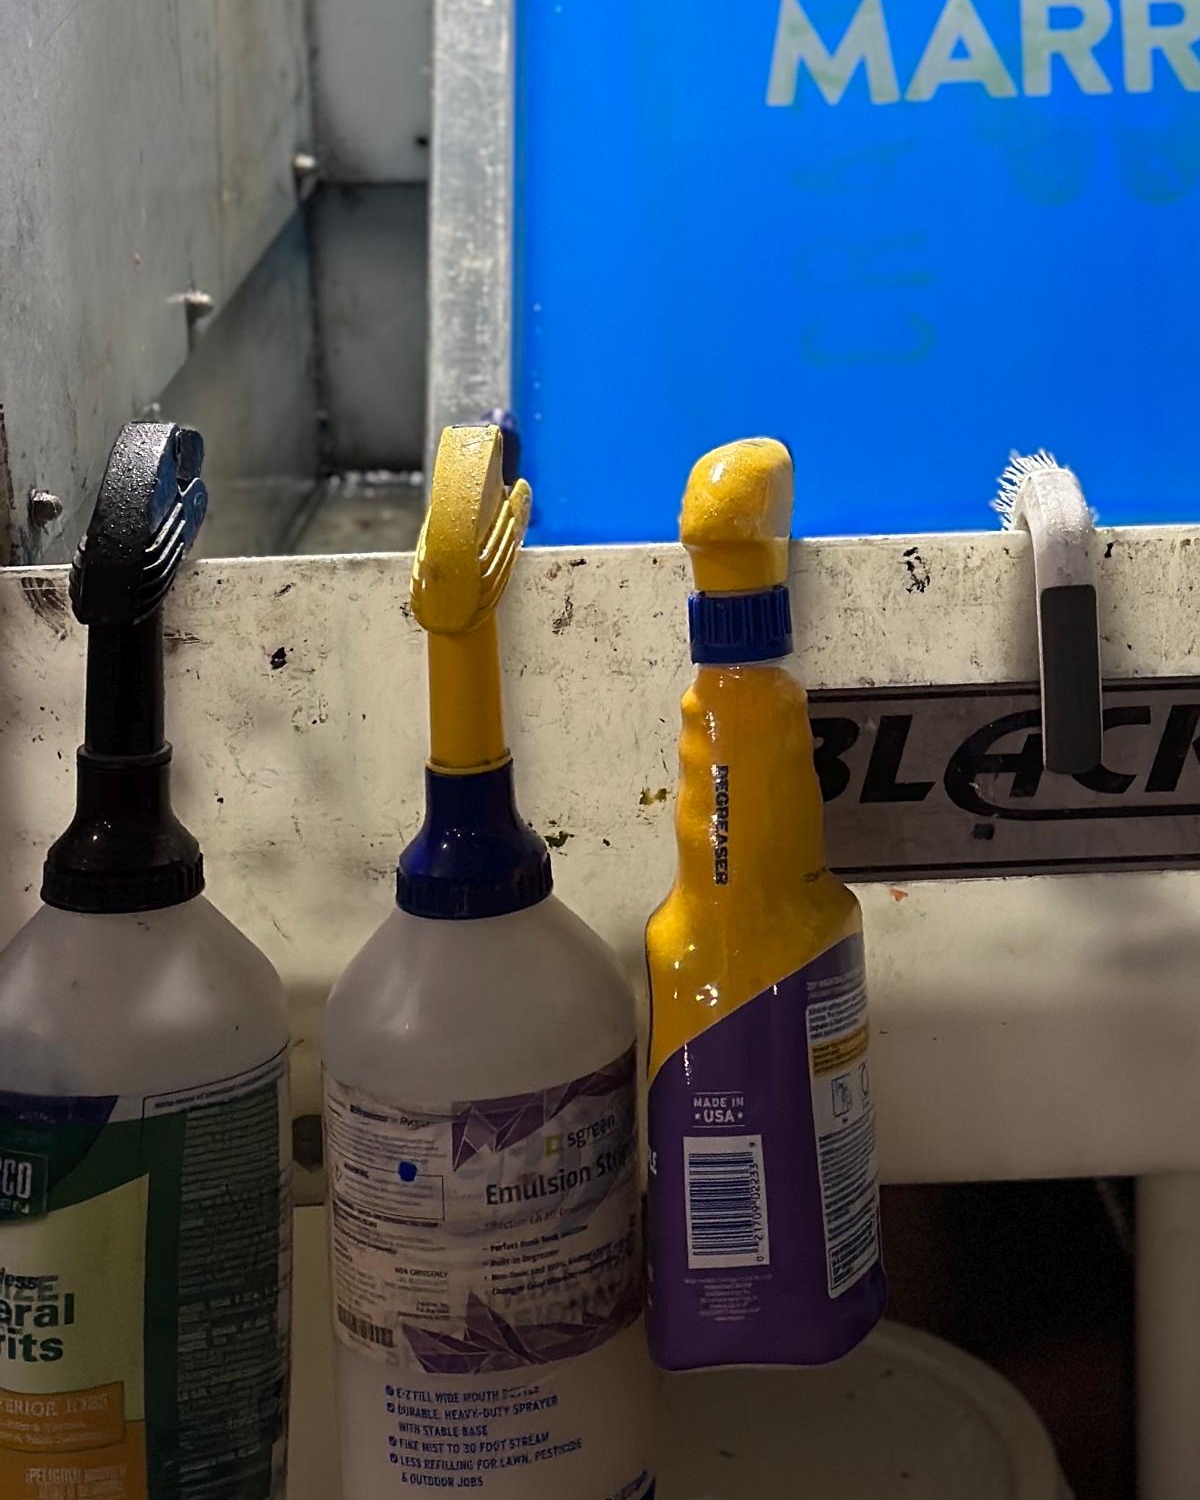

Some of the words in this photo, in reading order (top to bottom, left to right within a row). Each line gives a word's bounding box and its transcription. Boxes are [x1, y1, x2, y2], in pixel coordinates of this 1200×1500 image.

[715, 765, 729, 885] DEGREASER
[693, 1097, 727, 1108] MADE
[731, 1096, 744, 1107] IN
[703, 1109, 735, 1123] USA
[567, 1114, 615, 1148] sgreen
[0, 1157, 32, 1199] CO
[486, 1166, 591, 1205] Emulsion
[463, 1390, 499, 1402] MOUTH
[513, 1395, 558, 1415] SPRAYER
[423, 1425, 459, 1437] STABLE
[462, 1425, 488, 1437] BASE
[447, 1443, 460, 1454] TO
[479, 1439, 506, 1452] FOOT
[477, 1459, 497, 1470] FOR
[410, 1474, 454, 1487] OUTDOOR
[457, 1475, 484, 1487] JOBS
